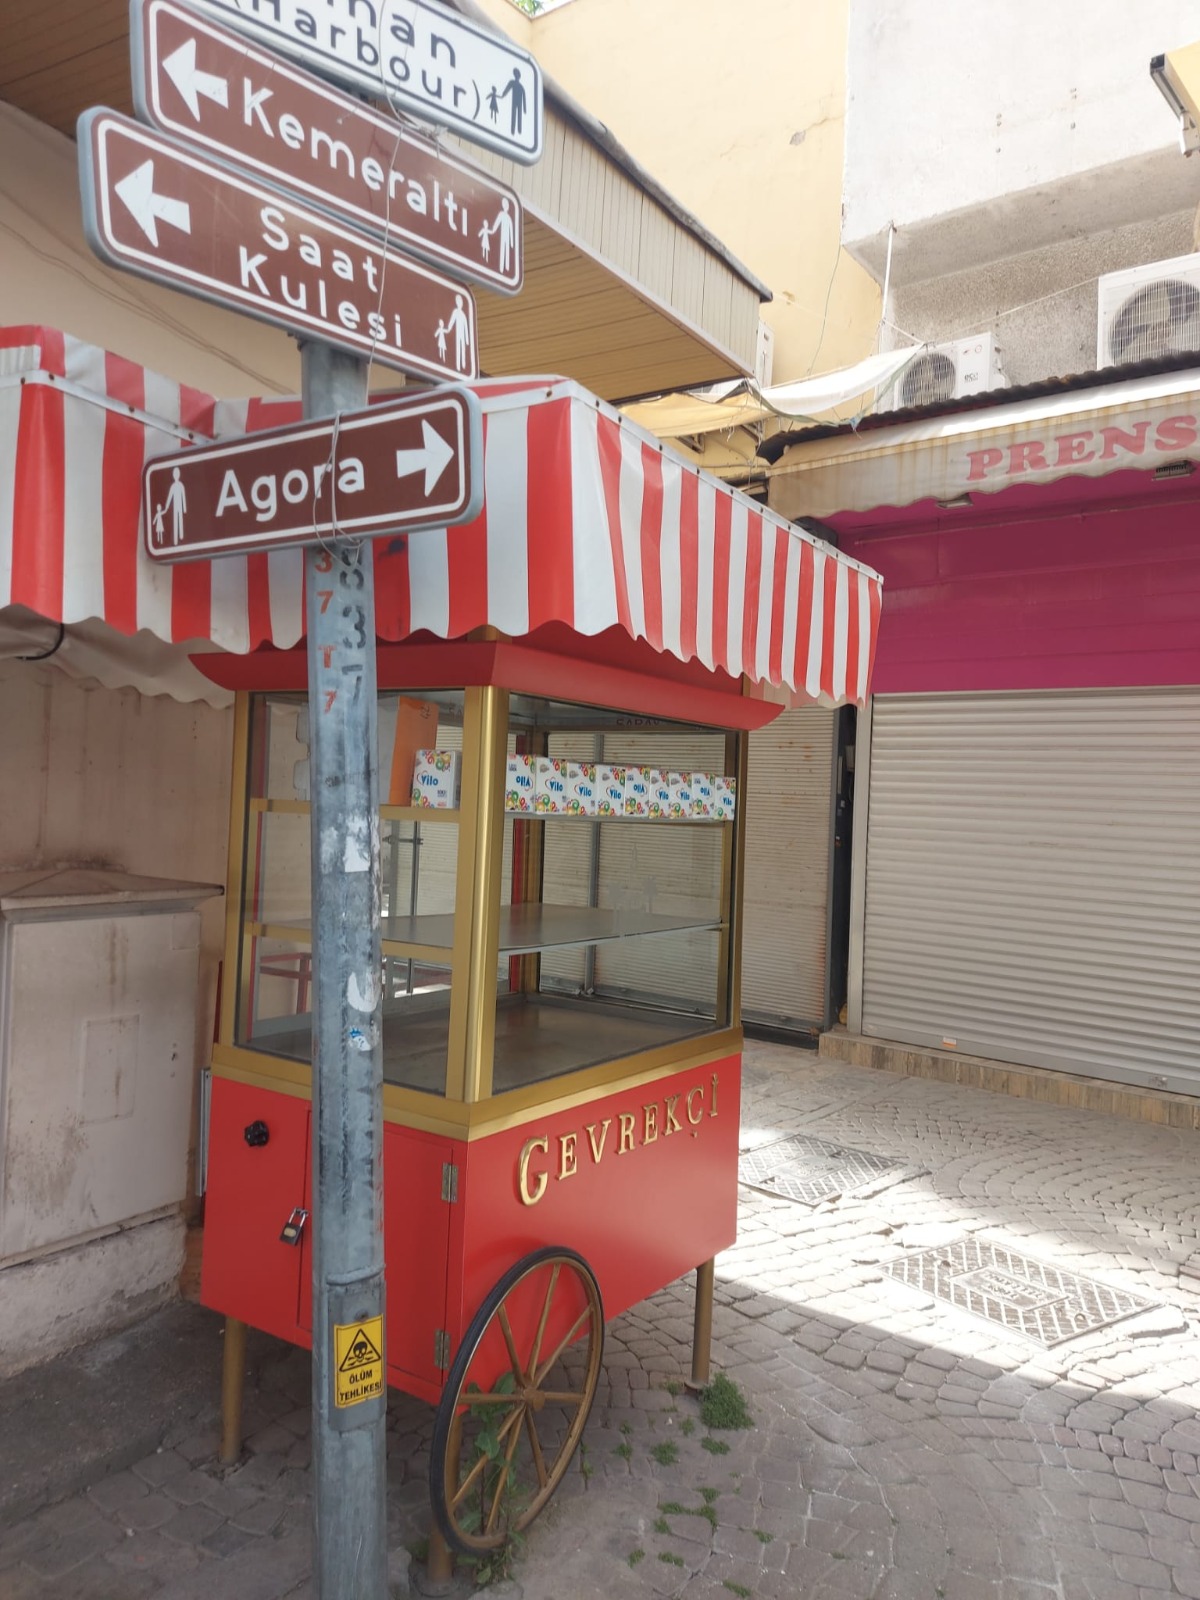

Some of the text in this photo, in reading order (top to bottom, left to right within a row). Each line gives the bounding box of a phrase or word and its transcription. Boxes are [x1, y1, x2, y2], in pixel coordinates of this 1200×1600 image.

[243, 76, 468, 238] Kemeraltı
[259, 206, 379, 293] Saat
[238, 246, 402, 347] Kulesi
[966, 415, 1198, 481] PRENS
[215, 457, 365, 522] Agora
[421, 774, 439, 787] Vilo
[549, 780, 564, 792] Vilo
[578, 785, 592, 797] Vilo
[609, 788, 622, 800] Vilo
[518, 1072, 719, 1207] GEVREKÇİ
[349, 1369, 373, 1385] ÖLÜM
